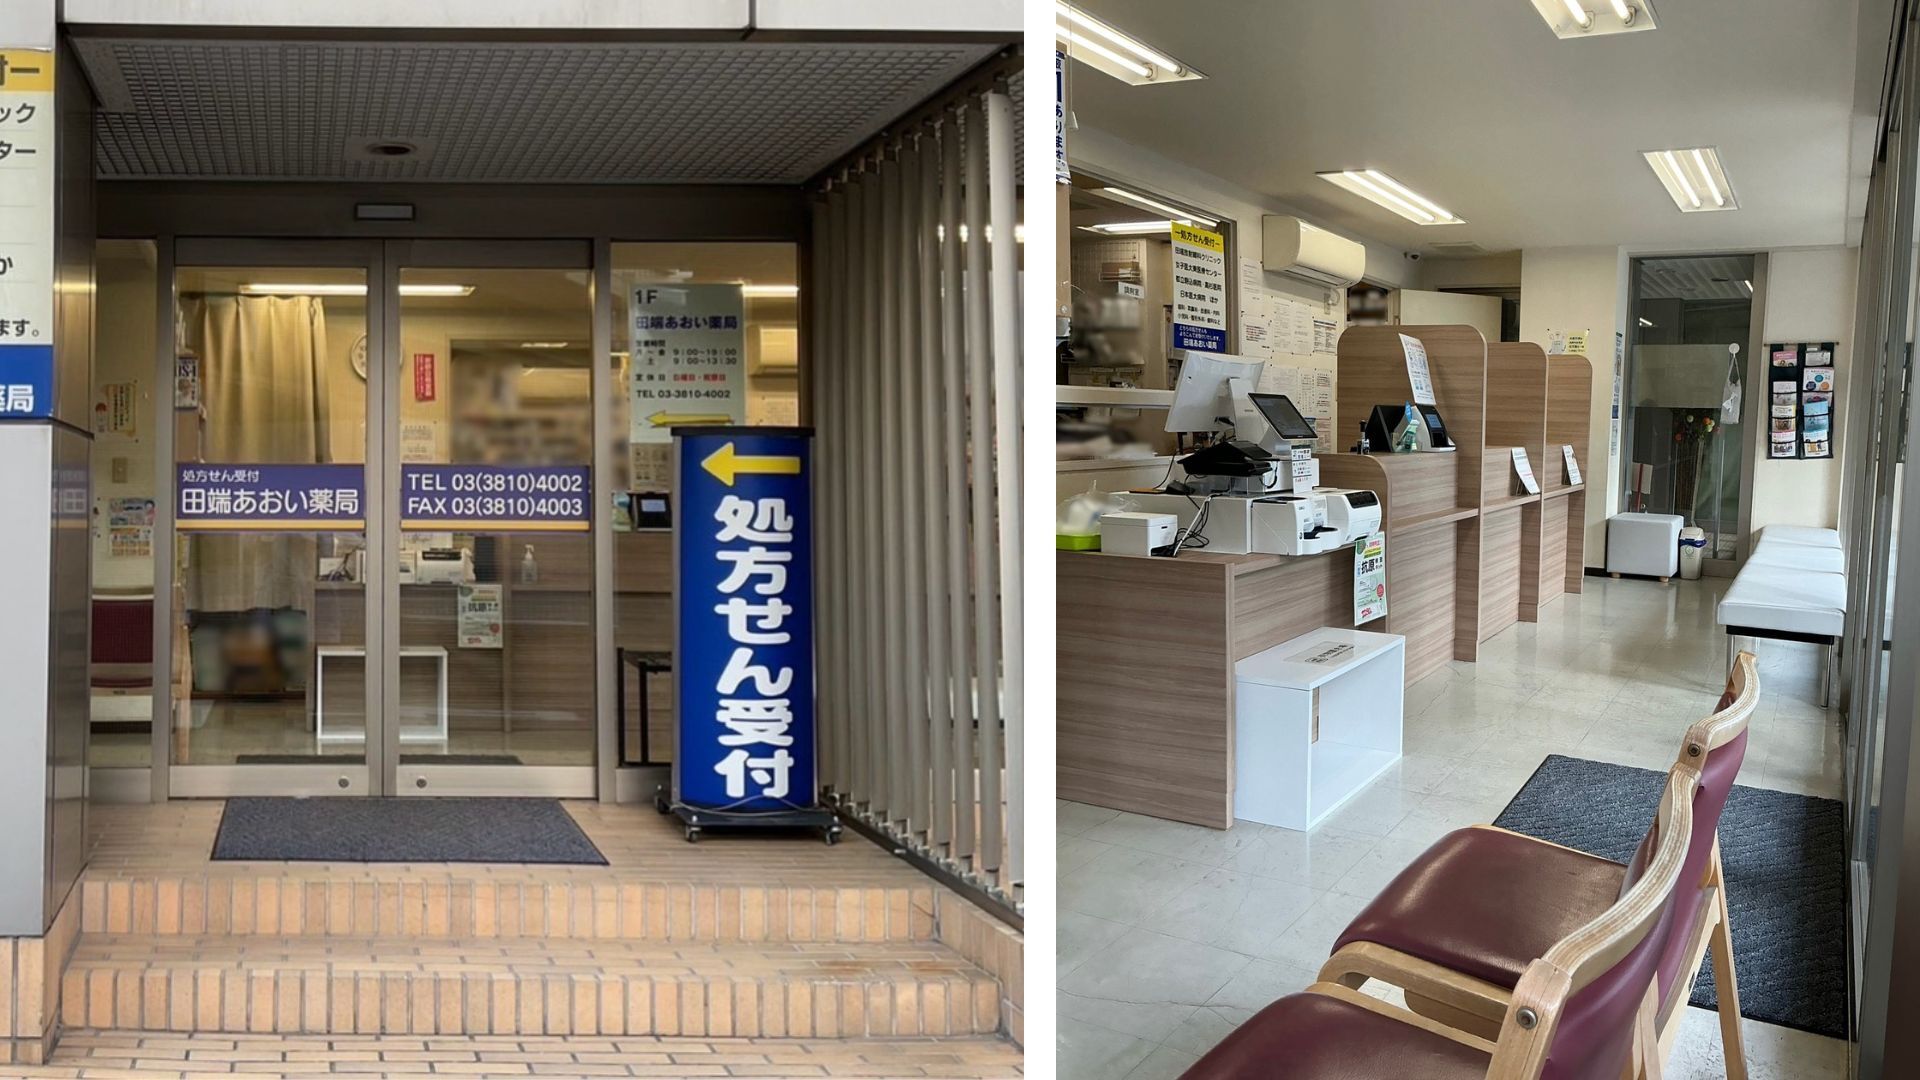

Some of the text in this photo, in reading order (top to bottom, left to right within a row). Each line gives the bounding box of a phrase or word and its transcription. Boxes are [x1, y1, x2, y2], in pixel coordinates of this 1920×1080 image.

[635, 290, 658, 304] 1F
[636, 316, 738, 329] 田端あおい薬局
[0, 384, 34, 412] 局
[636, 390, 731, 398] TEL 03-3810-4002
[182, 470, 260, 483] 処方せん受付
[408, 473, 583, 493] TEL 03(3810)4002
[181, 488, 359, 515] 田端あおい薬局
[408, 497, 583, 517] FAX 03(3810)4003
[713, 494, 794, 798] 処方せん受付
